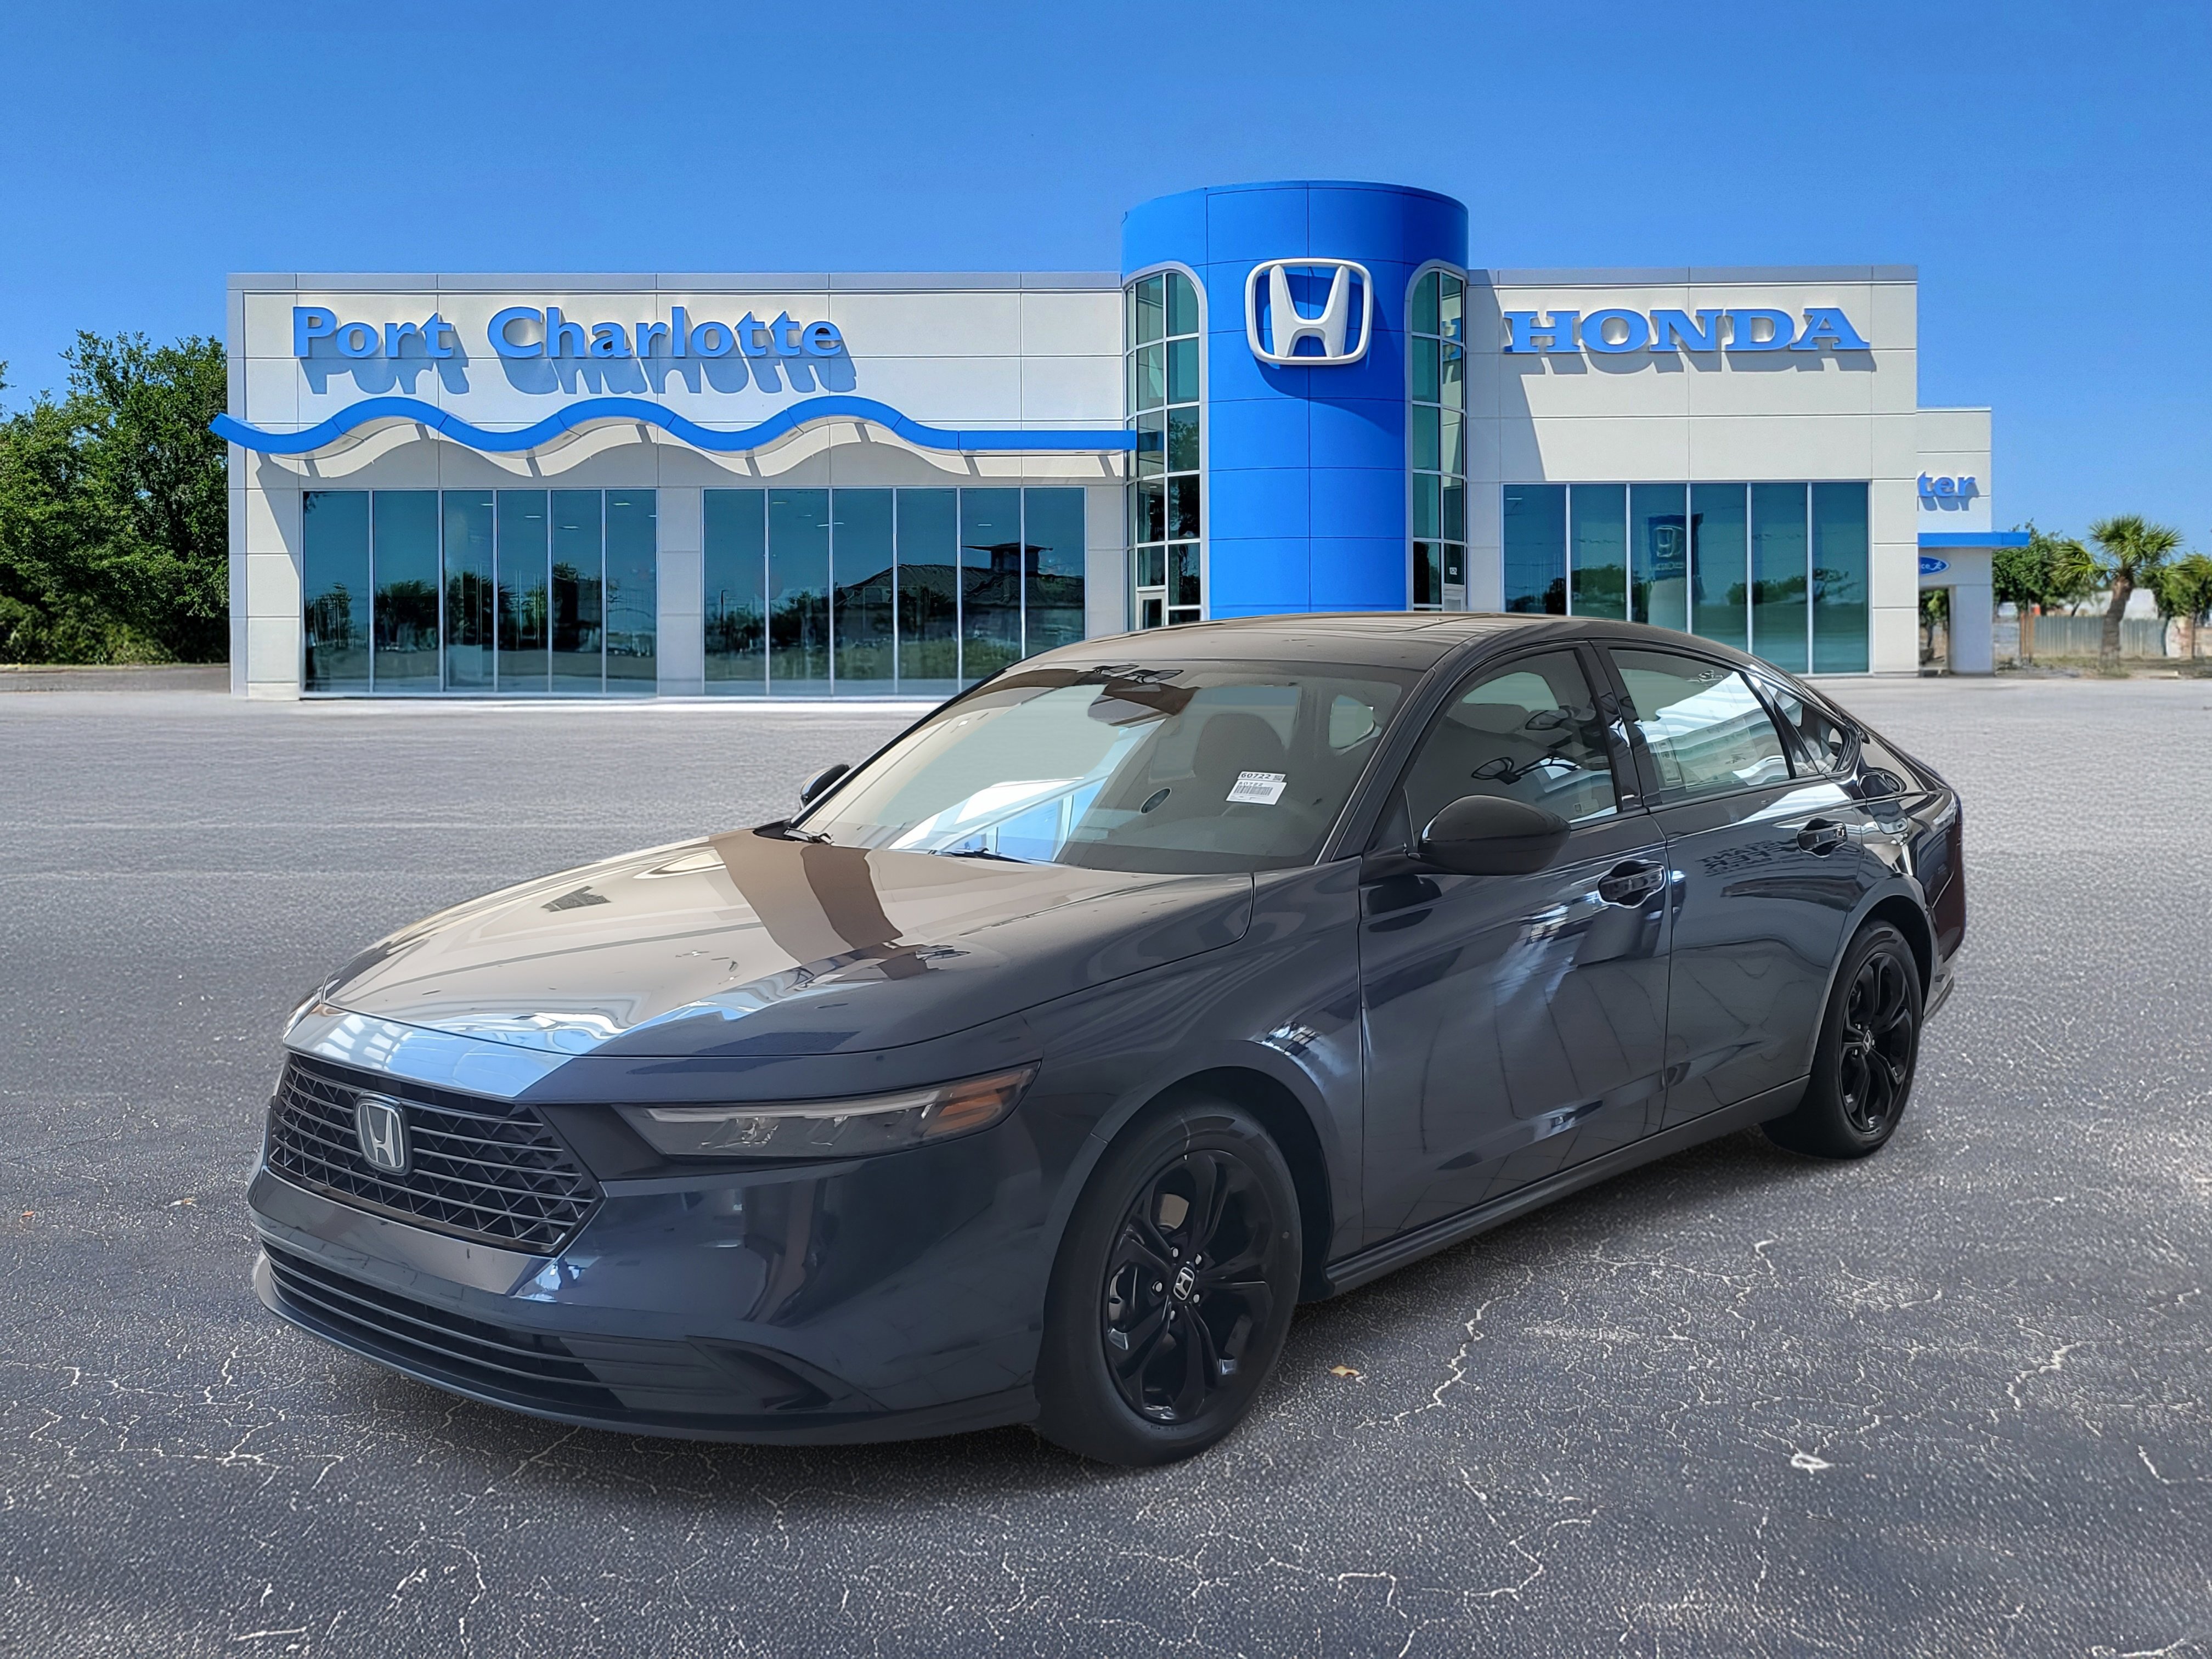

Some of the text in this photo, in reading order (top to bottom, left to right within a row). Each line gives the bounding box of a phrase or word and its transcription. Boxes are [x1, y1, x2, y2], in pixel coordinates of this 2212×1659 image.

[293, 306, 842, 358] Port Charlotte
[1503, 307, 1870, 353] HONDA
